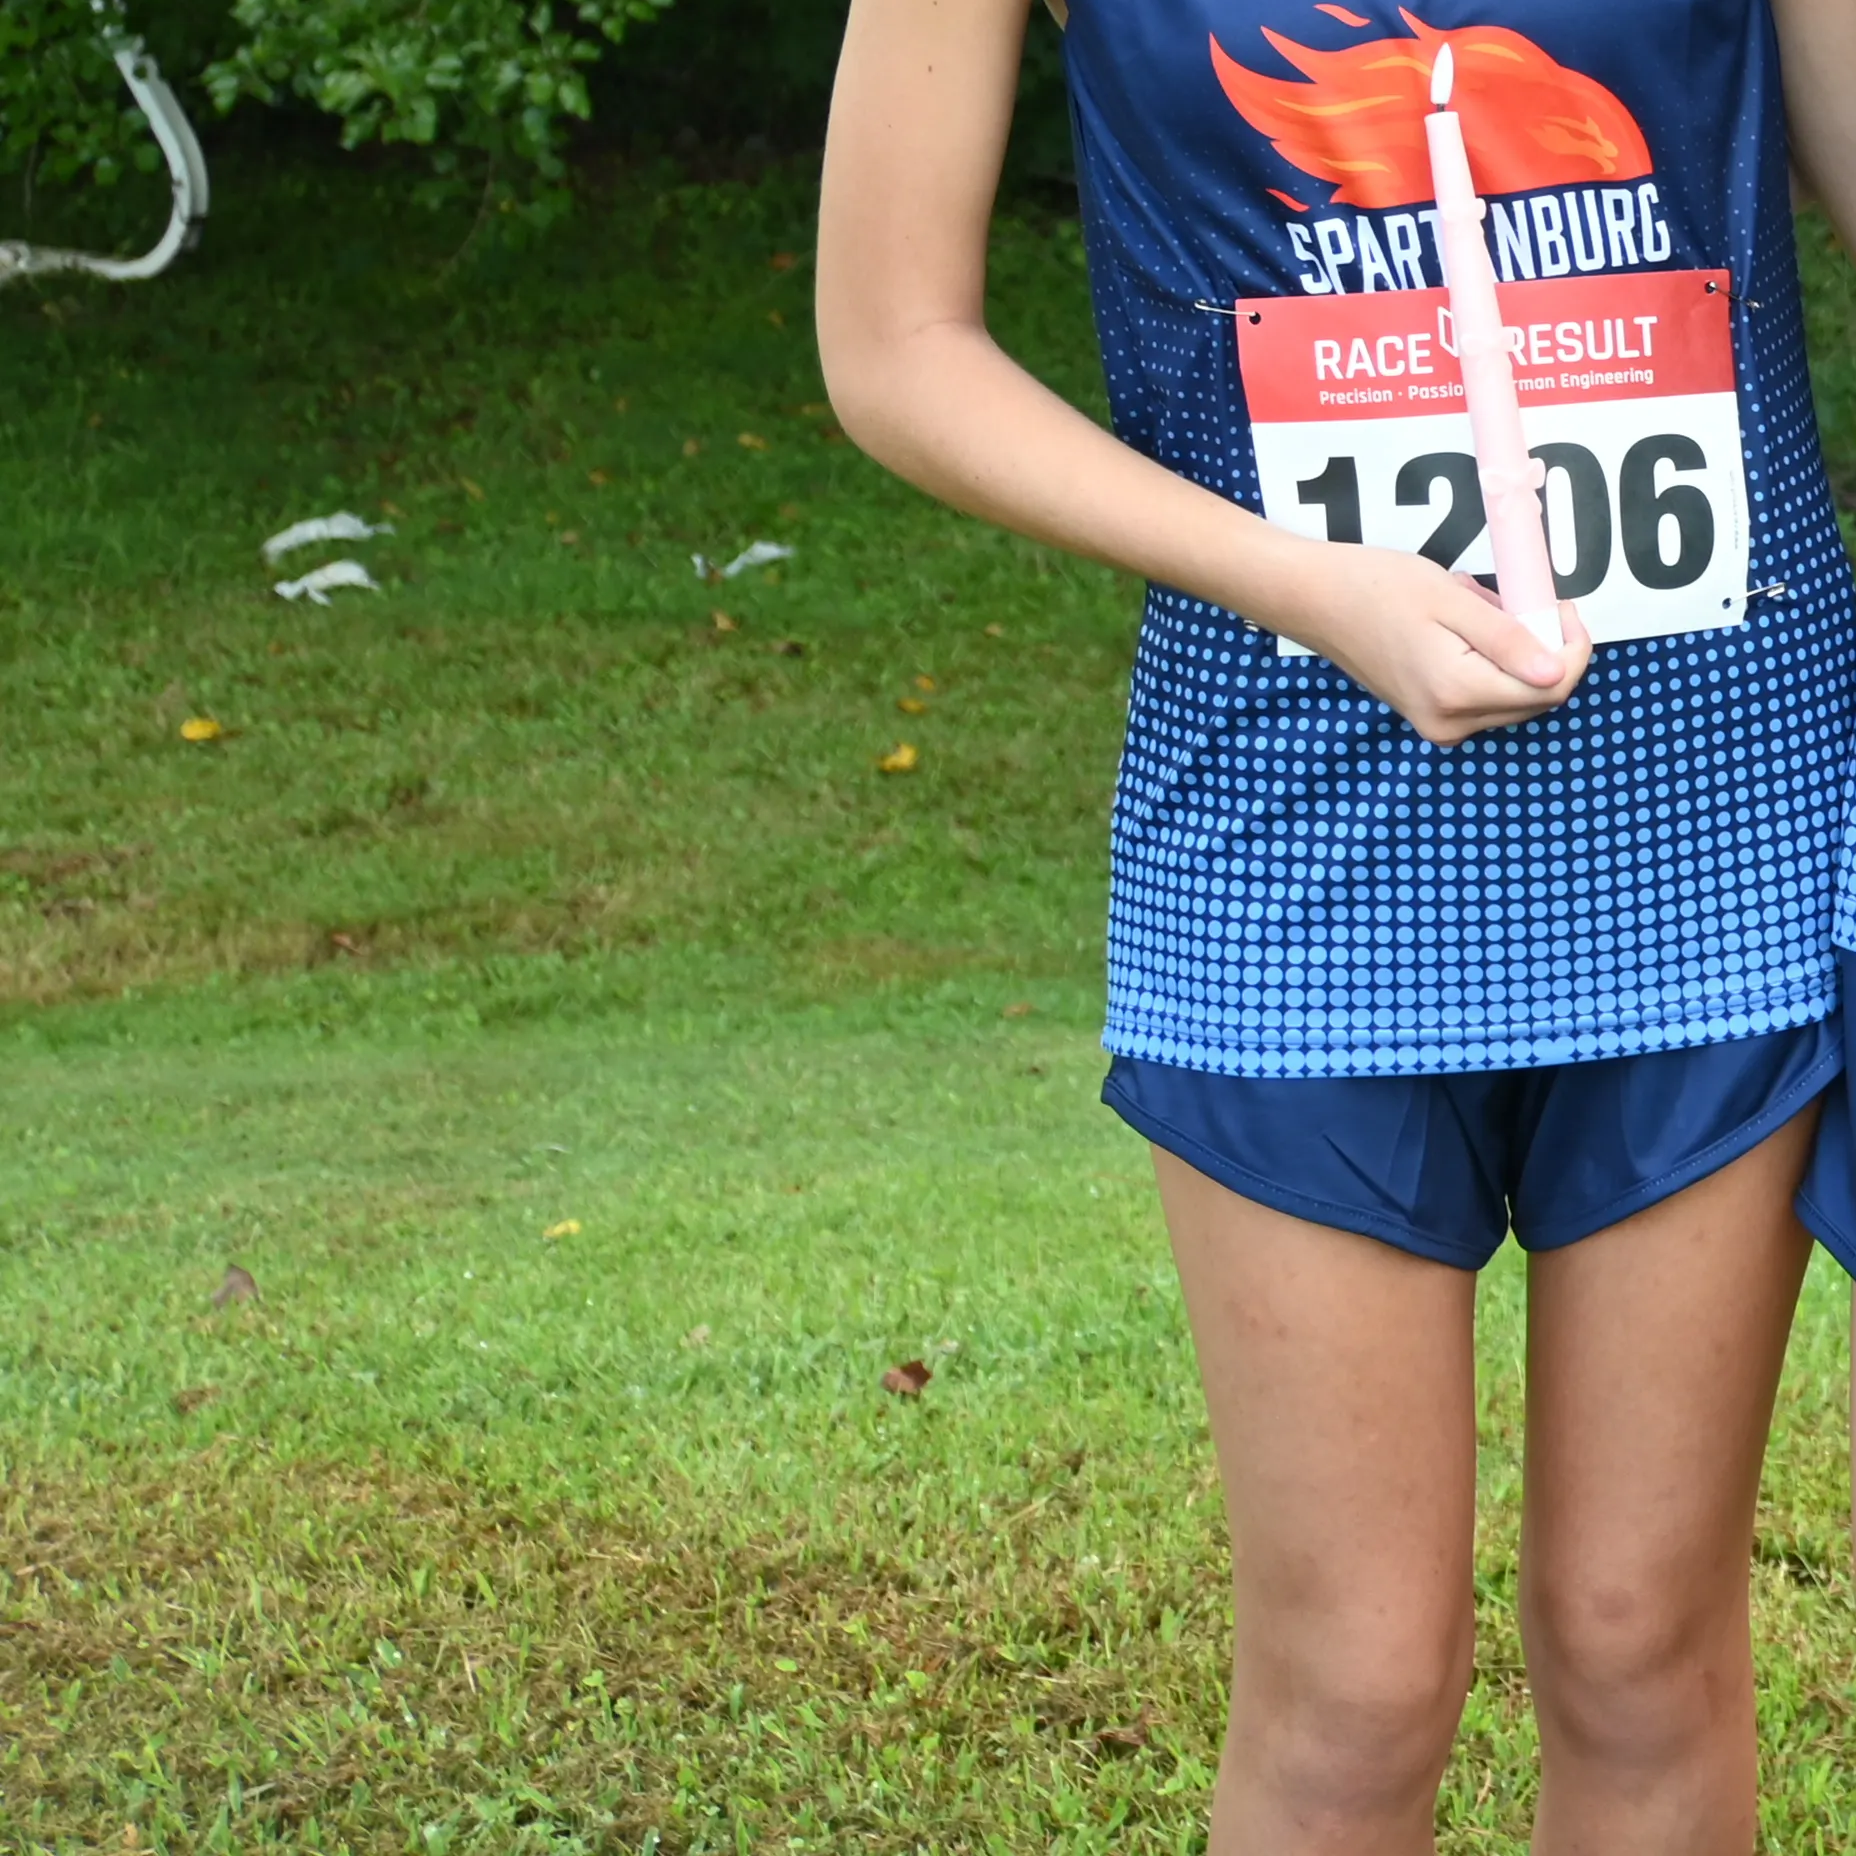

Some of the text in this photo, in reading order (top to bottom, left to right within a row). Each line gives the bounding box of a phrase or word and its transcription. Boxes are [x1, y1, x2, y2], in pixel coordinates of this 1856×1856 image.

[1286, 182, 1670, 295] SPARTNBURG
[1314, 332, 1434, 380] RACE
[1319, 368, 1655, 405] Precision Passio rman Engineering
[1296, 433, 1715, 600] 1206
